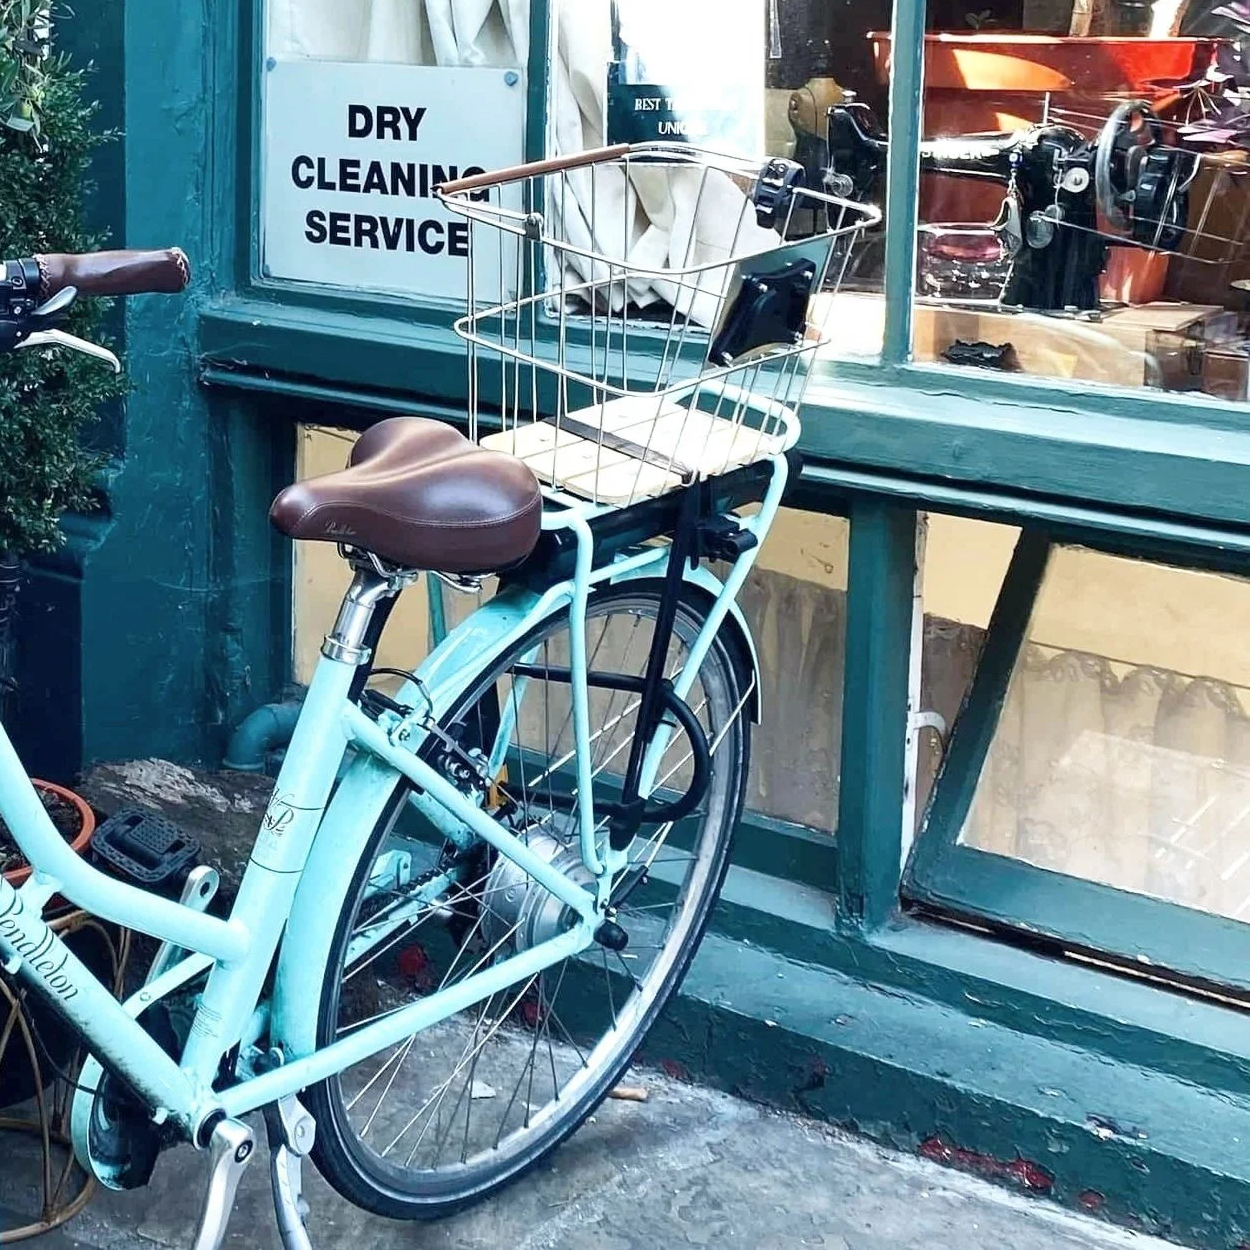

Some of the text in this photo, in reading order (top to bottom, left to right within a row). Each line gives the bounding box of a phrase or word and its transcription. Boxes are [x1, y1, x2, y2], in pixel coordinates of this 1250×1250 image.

[348, 104, 427, 141] DRY
[634, 97, 661, 111] BEST
[305, 210, 469, 257] SERVICE
